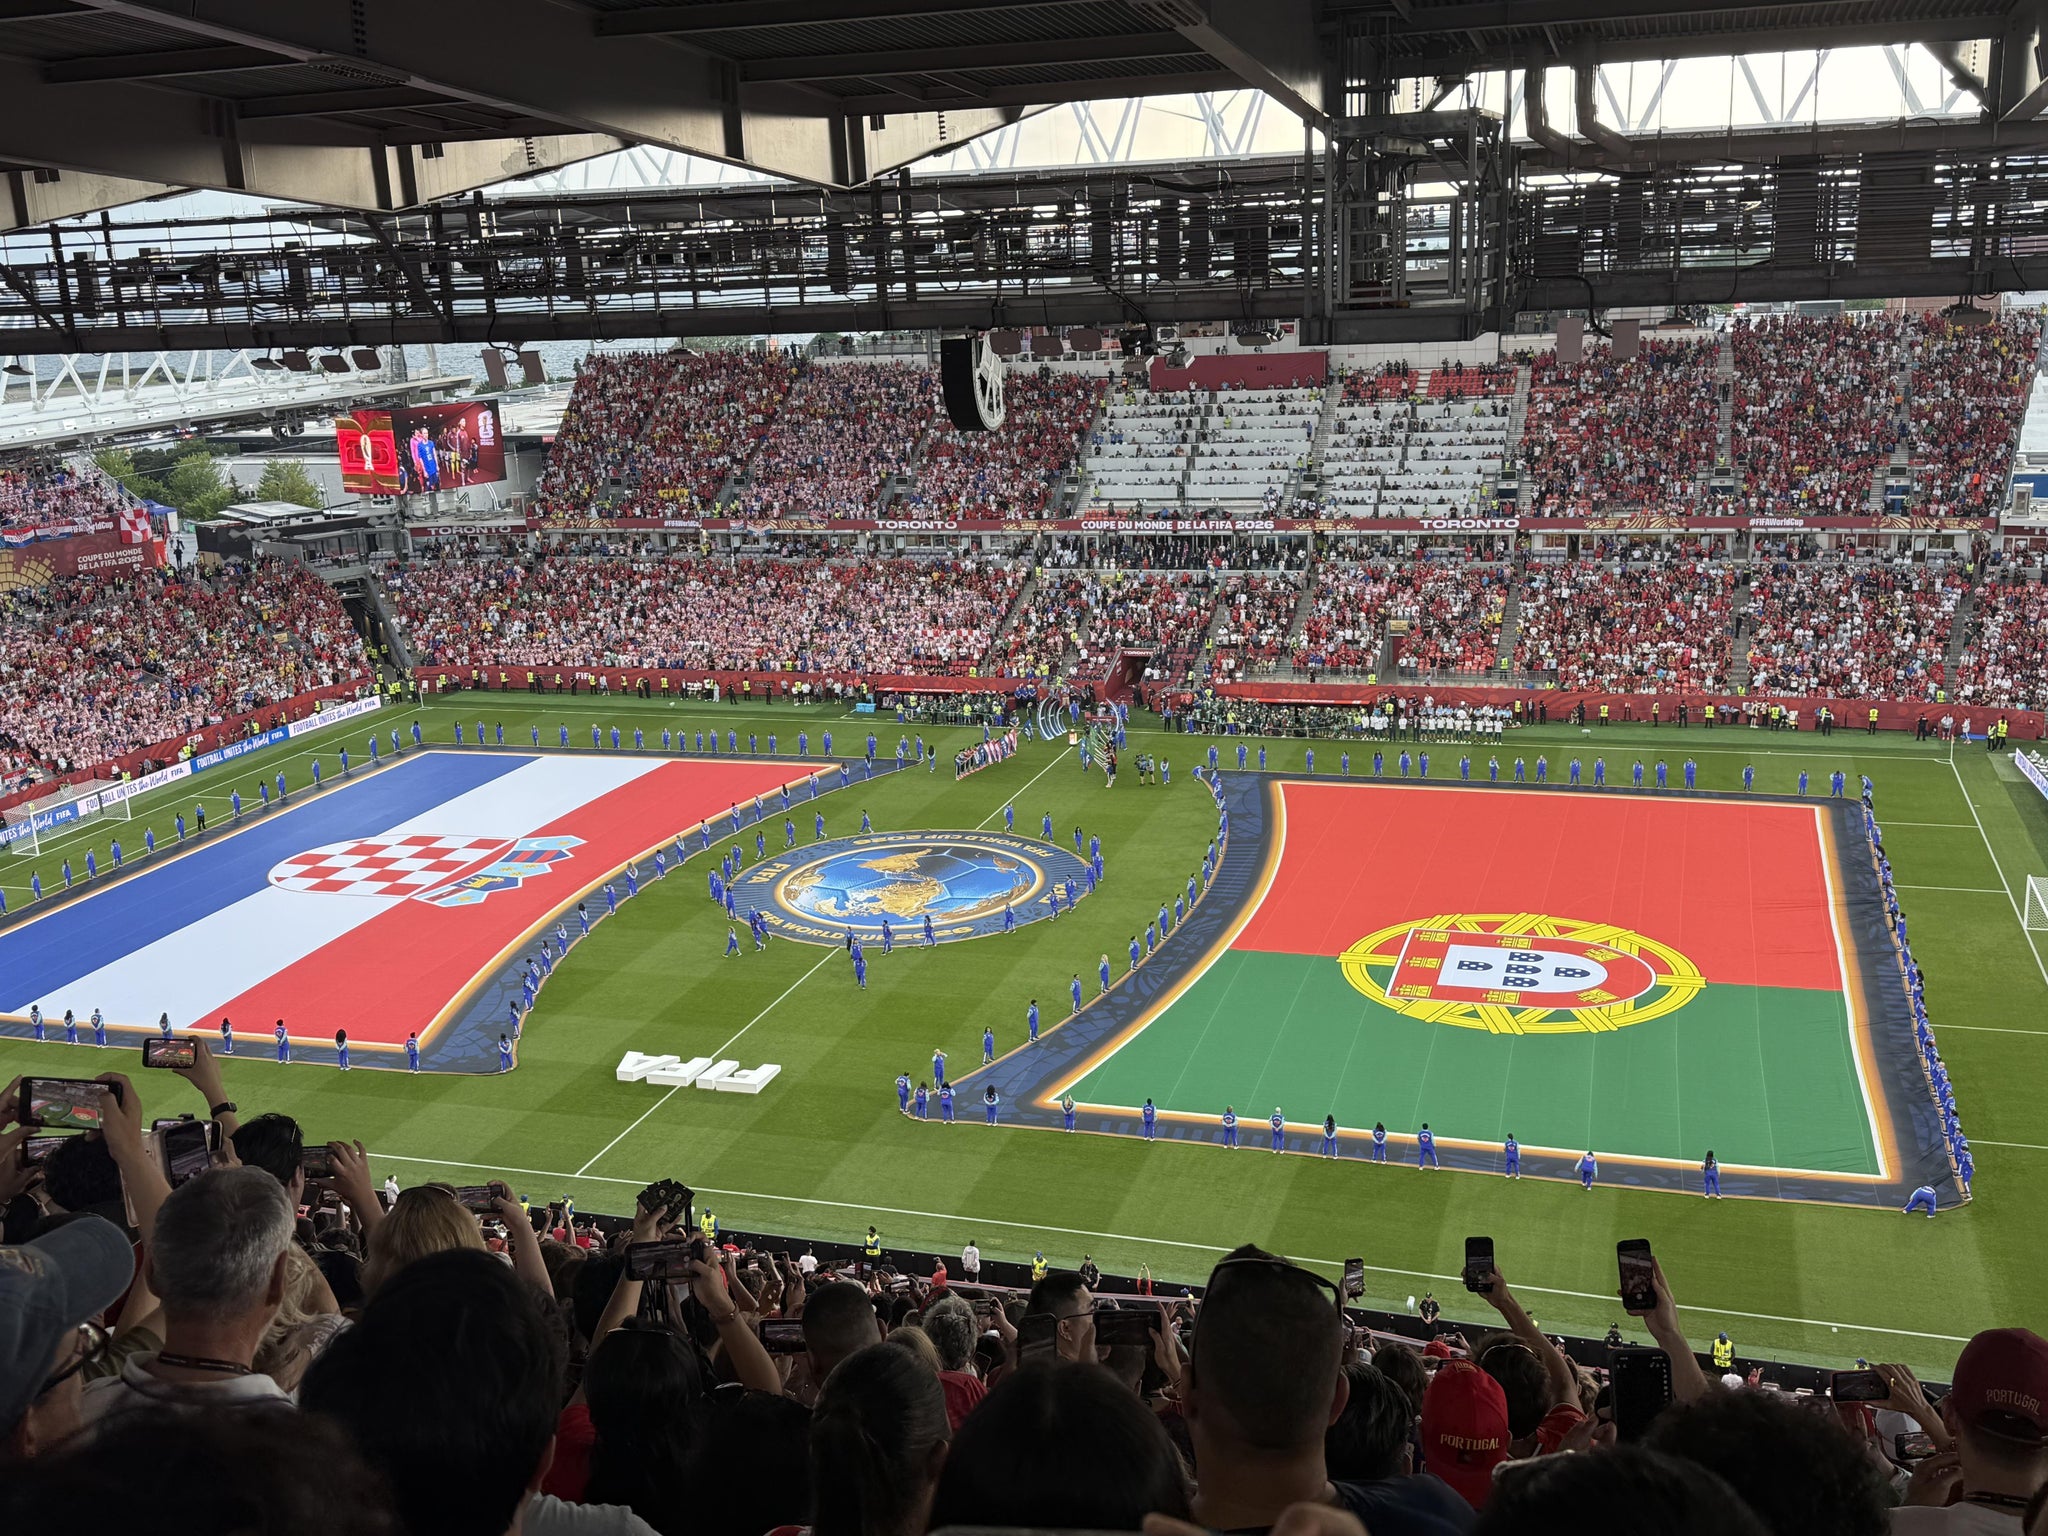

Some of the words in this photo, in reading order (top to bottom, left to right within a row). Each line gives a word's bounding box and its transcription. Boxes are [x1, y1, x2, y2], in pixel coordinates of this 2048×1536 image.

[427, 526, 511, 536] TORONTO
[663, 520, 700, 528] #FIFAWorldCu
[875, 520, 958, 530] TORONTO
[1081, 520, 1117, 530] COUPE
[1117, 521, 1132, 530] DU
[1134, 521, 1173, 530] MONDE
[1177, 521, 1191, 530] DE
[1193, 521, 1208, 530] LA
[1209, 521, 1233, 529] FIFA
[1235, 520, 1275, 529] 2026
[1420, 519, 1520, 529] TORONTO
[1749, 518, 1804, 527] #FIFAWorldCup
[77, 553, 104, 563] COUPE
[103, 551, 115, 559] DU
[115, 547, 143, 557] MONDE
[78, 563, 88, 571] DE
[89, 561, 100, 569] LA
[100, 559, 117, 567] FIFA
[118, 554, 145, 564] 2026
[293, 717, 318, 734] FOOTBALL
[319, 711, 336, 724] UNITES
[336, 709, 347, 719] the
[346, 702, 362, 716] World
[364, 700, 376, 709] FIFA
[196, 751, 223, 769] FOOTBALL
[223, 744, 242, 759] UNITES
[242, 740, 253, 753] the
[252, 732, 270, 749] World
[271, 730, 284, 740] FIFA
[86, 789, 118, 809] FOOBALL
[116, 783, 138, 799] UNTES
[137, 780, 150, 791] the
[149, 770, 169, 787] World
[171, 767, 184, 777] FIFA
[17, 821, 31, 837] the
[33, 812, 54, 831] World
[55, 809, 72, 820] FIFA
[964, 834, 1023, 848] WORLD
[1022, 844, 1055, 858] FIFA
[746, 862, 792, 884] FIFA
[782, 922, 845, 939] WORLD
[616, 1050, 782, 1095] FIFA
[1986, 1388, 2041, 1416] PORTUGAL
[1440, 1433, 1500, 1451] PORTUGAL
